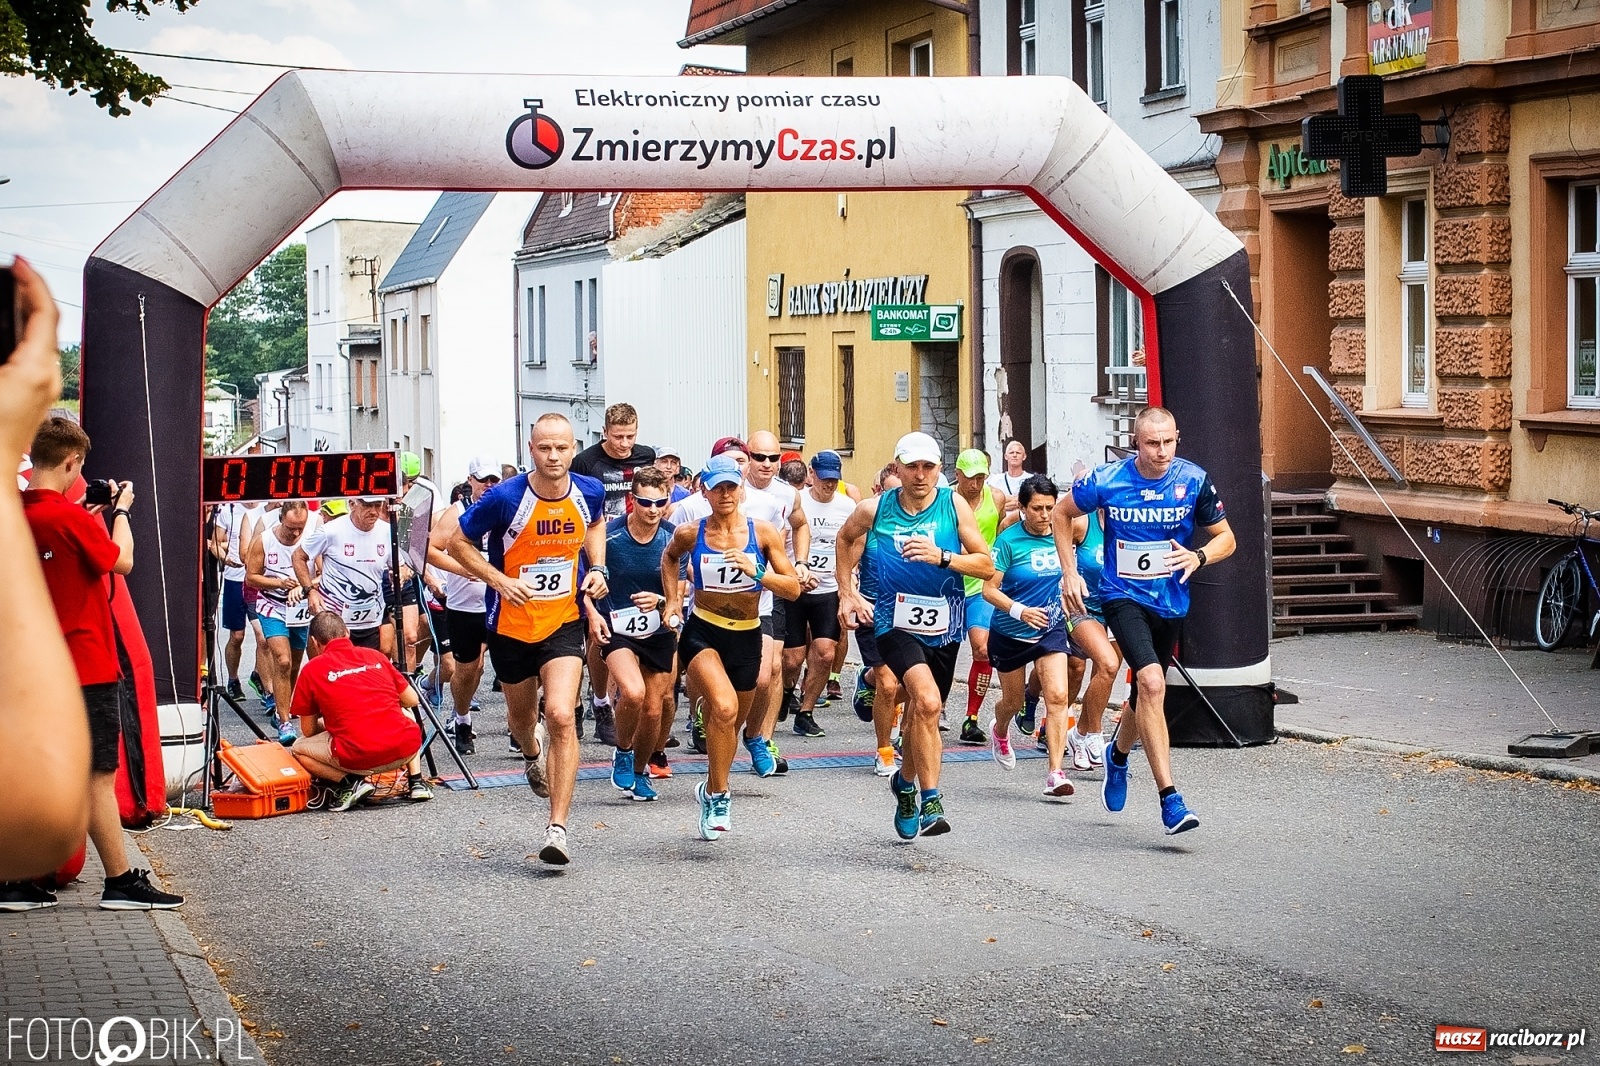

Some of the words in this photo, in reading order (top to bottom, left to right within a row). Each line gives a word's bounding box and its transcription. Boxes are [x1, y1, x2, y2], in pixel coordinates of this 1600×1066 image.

[1373, 27, 1430, 64] KRANOWITZ
[575, 89, 730, 112] Elektroniczny
[737, 91, 813, 112] pomiar
[820, 93, 881, 107] czasu
[1341, 129, 1389, 142] APTEKA
[572, 126, 896, 169] ZmierzymyCzas.pl
[787, 283, 821, 315] BANK
[821, 267, 927, 313] SPÓŁDZIELCZY
[876, 309, 929, 320] BANKOMAT
[222, 459, 247, 499] 0
[269, 456, 324, 497] 00
[341, 453, 394, 496] 02
[537, 519, 562, 536] ULC
[809, 555, 829, 569] 32
[1137, 552, 1151, 572] 6
[535, 573, 561, 591] 38
[717, 566, 743, 584] 12
[295, 608, 311, 621] 46
[351, 609, 371, 622] 37
[908, 606, 939, 627] 33
[625, 615, 649, 634] 43
